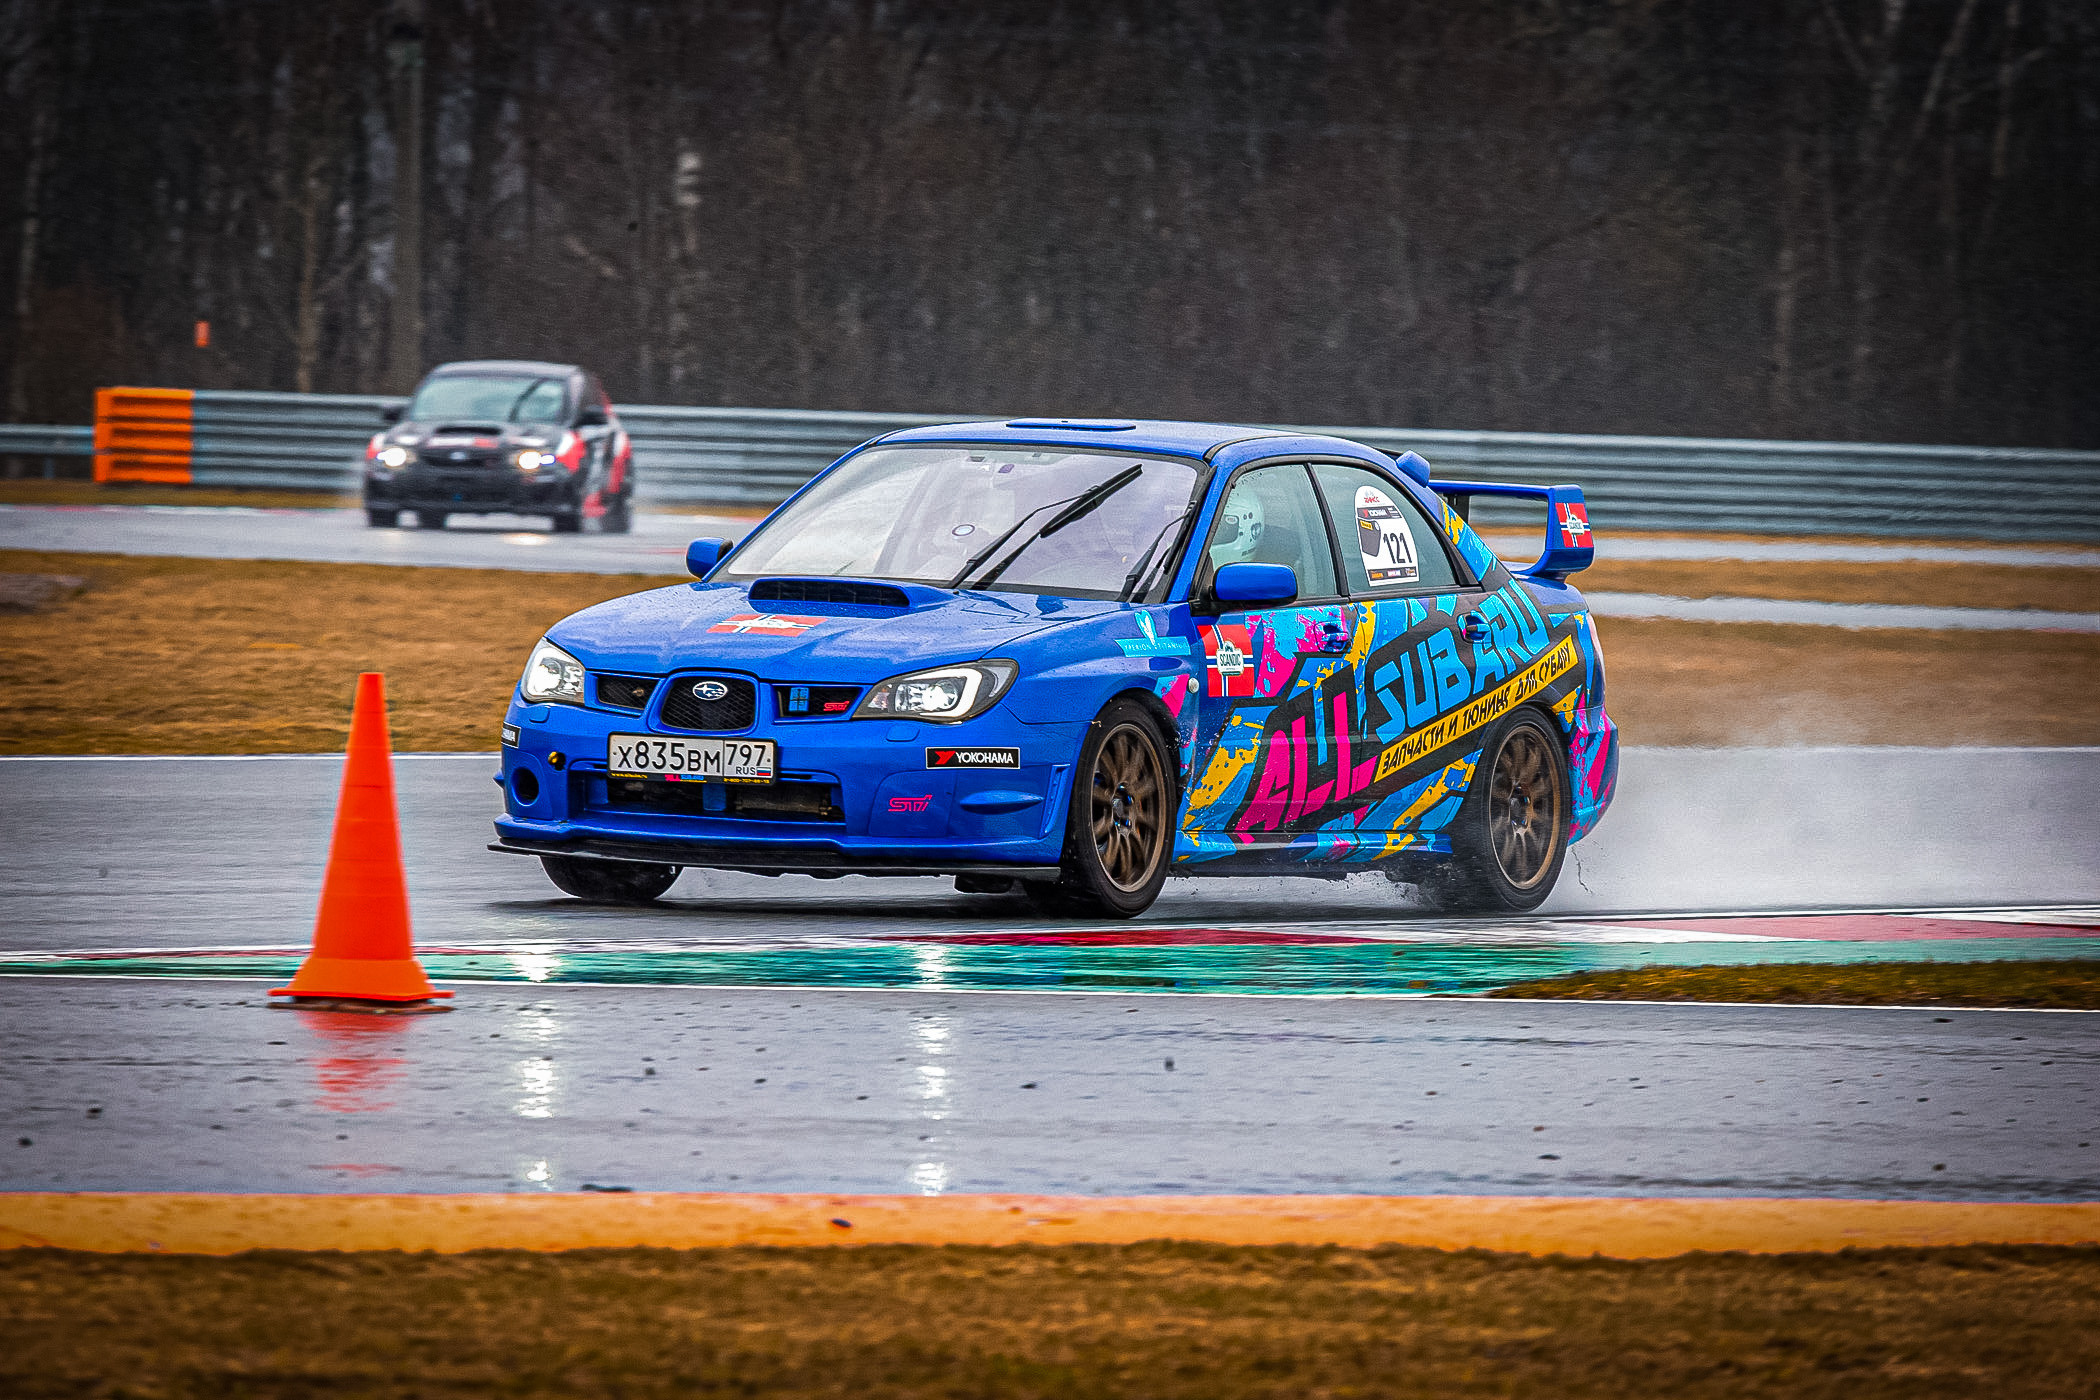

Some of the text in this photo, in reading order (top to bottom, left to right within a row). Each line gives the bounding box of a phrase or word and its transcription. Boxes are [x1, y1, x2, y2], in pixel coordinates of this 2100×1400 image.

[1383, 532, 1413, 564] 121
[1219, 653, 1242, 667] SCANDIC
[1374, 579, 1550, 745] SUBARU
[1382, 642, 1571, 774] ЗАПЧАСТИ И ТЮНИНГ ДЛЯ СУБАРУ
[725, 743, 767, 767] 797
[955, 751, 1014, 764] YOKOHAMA
[1235, 691, 1378, 845] ALL
[735, 766, 756, 776] RUS
